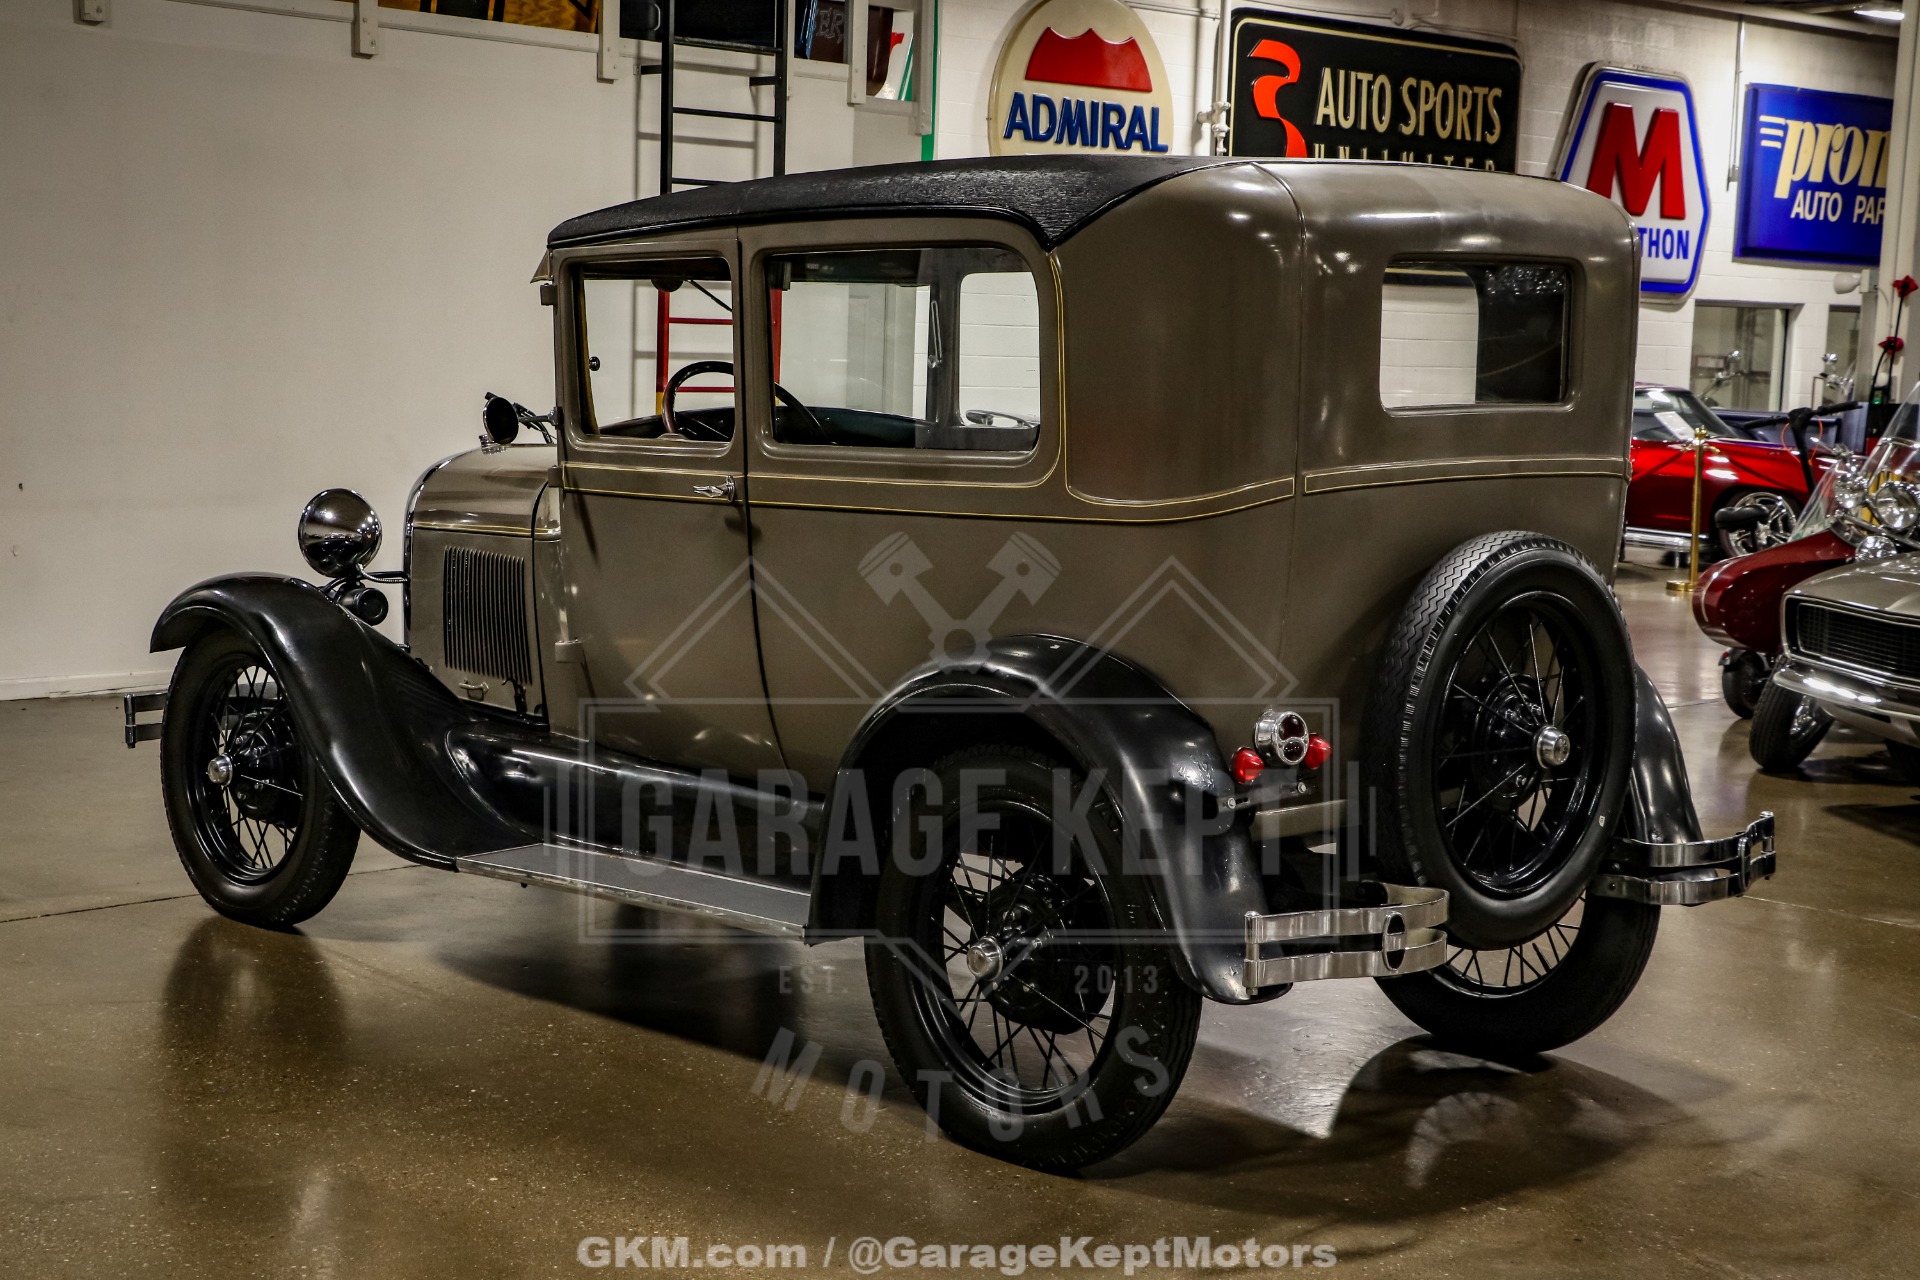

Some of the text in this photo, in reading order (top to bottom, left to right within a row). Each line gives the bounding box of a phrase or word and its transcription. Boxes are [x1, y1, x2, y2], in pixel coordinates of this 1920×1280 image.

[1003, 91, 1169, 153] ADMIRAL
[1314, 67, 1503, 145] AUTO SPORTS
[1790, 189, 1843, 222] AUTO
